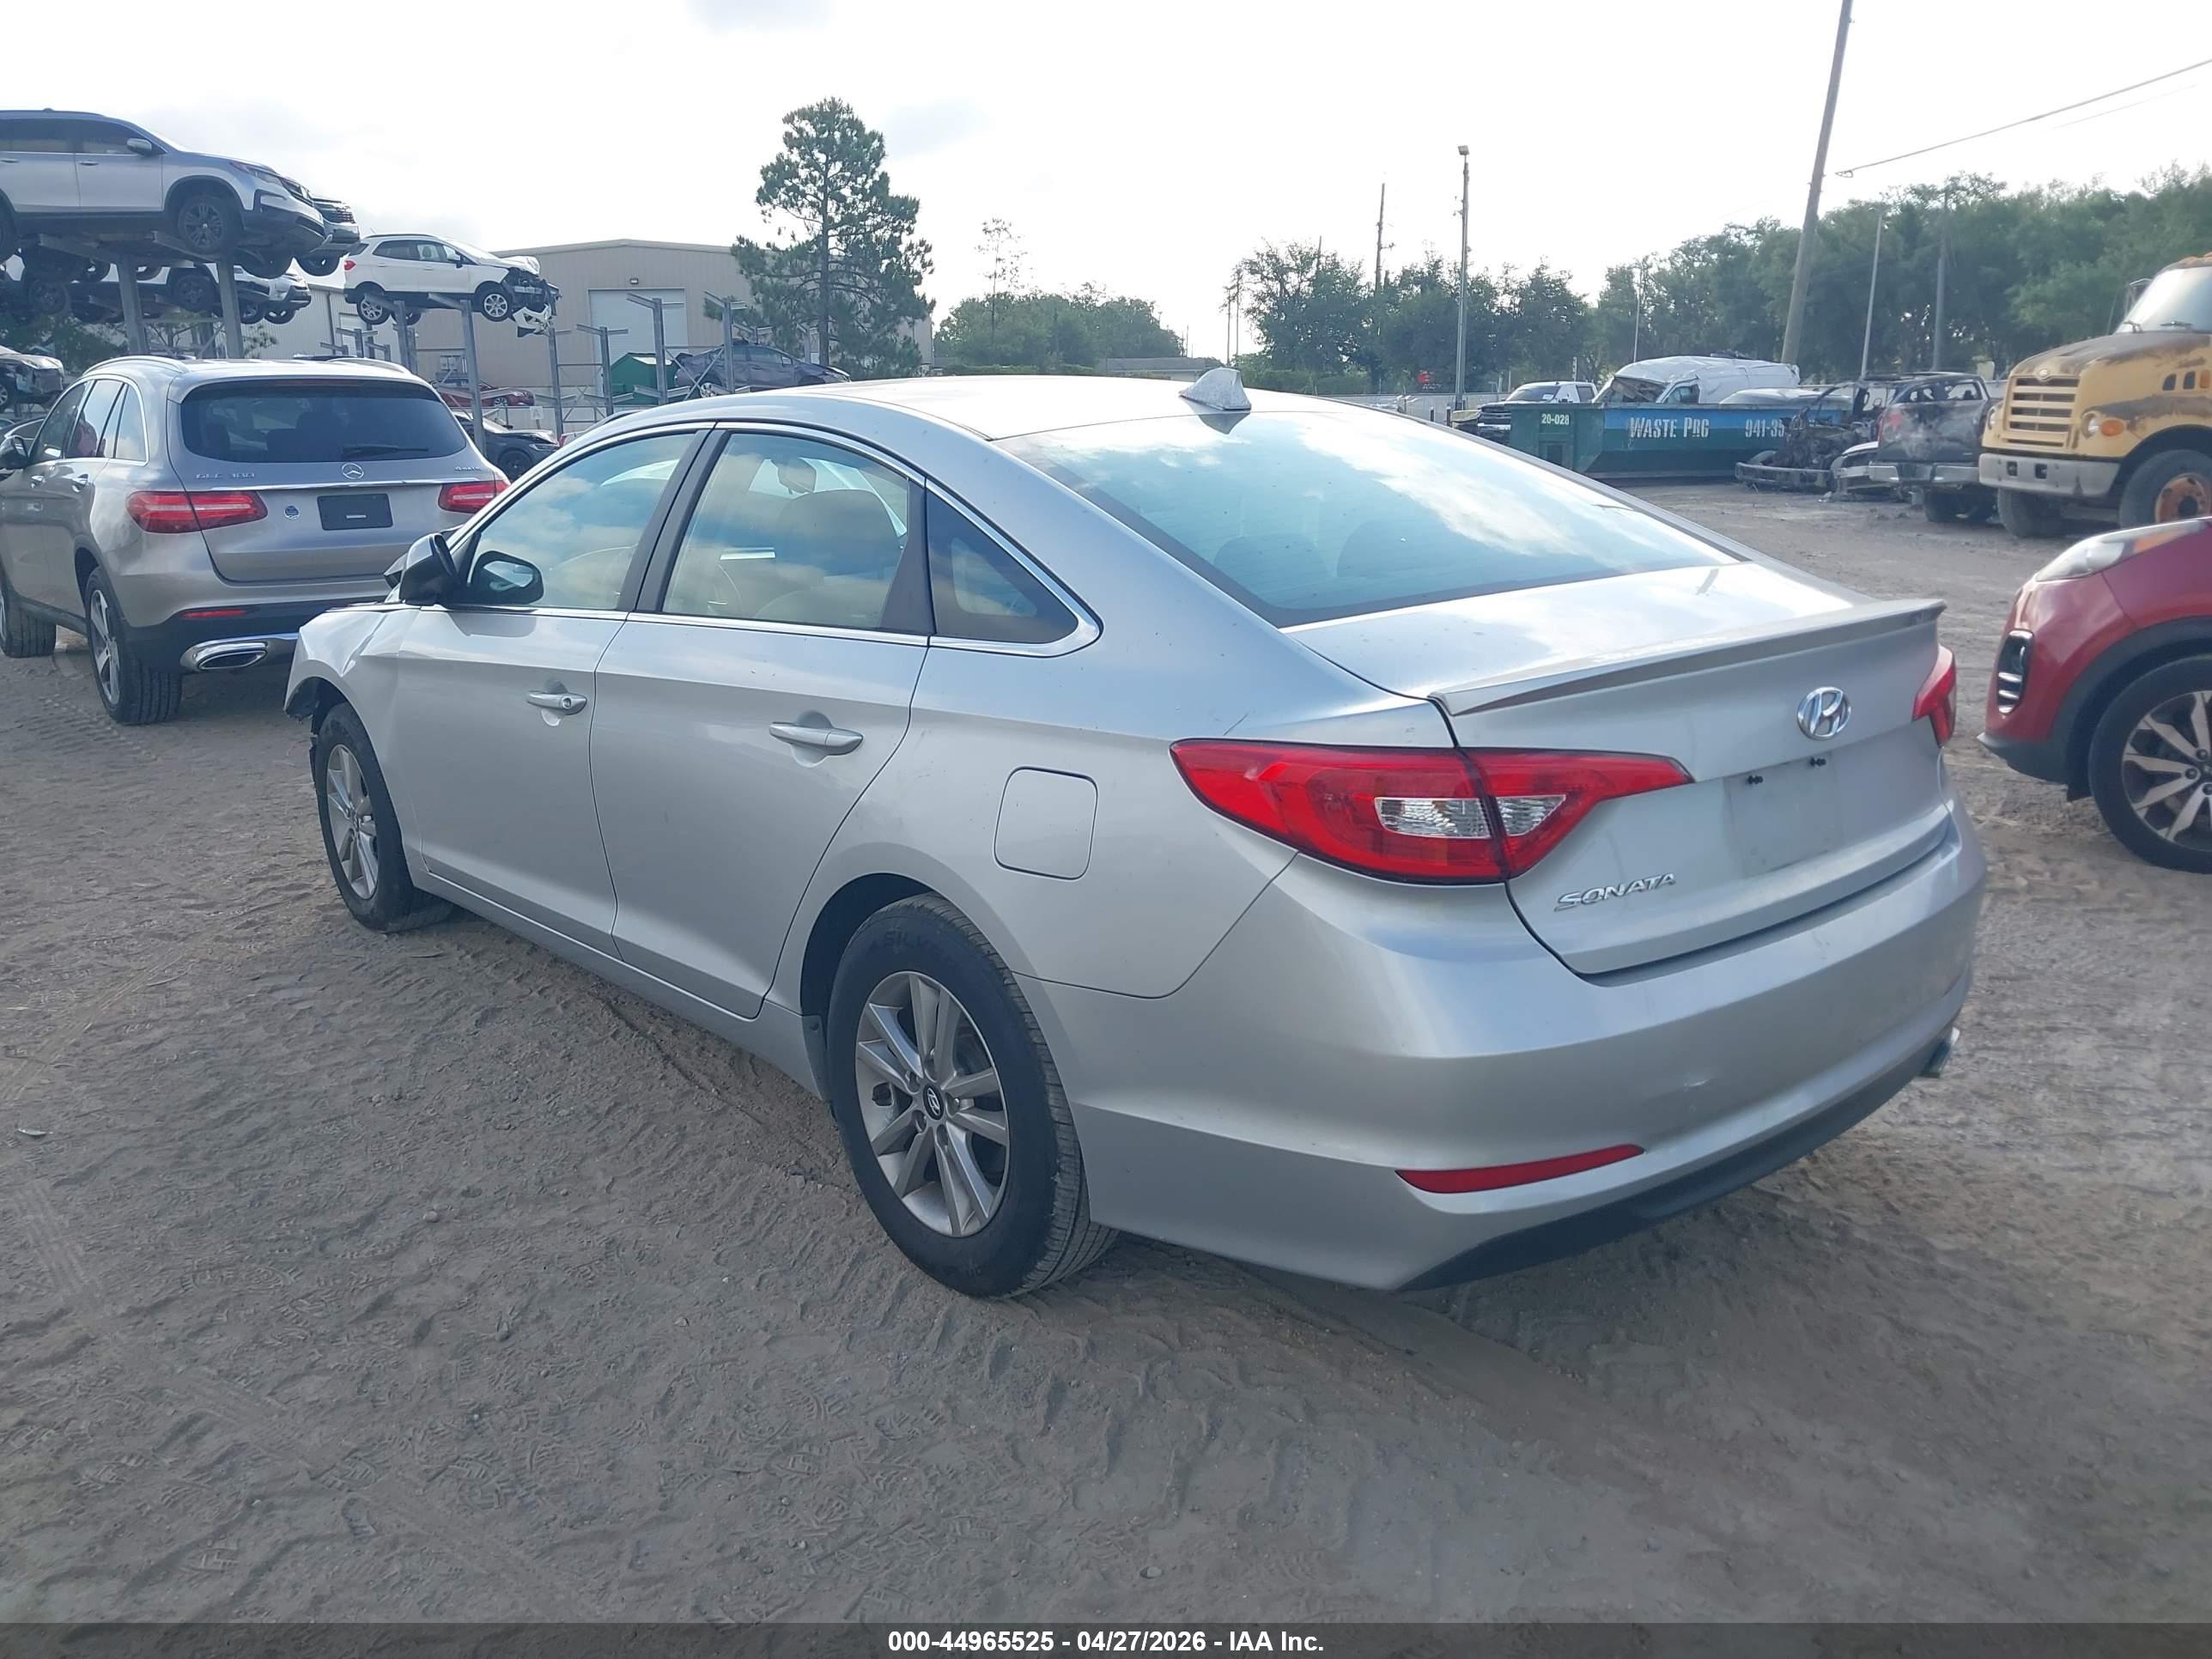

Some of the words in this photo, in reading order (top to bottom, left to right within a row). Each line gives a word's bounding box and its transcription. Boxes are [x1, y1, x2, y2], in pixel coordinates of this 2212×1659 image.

[1541, 413, 1570, 426] 20-028
[1630, 417, 1678, 438] WASTE
[1745, 418, 1785, 438] 941-35
[1553, 872, 1676, 912] SONATA
